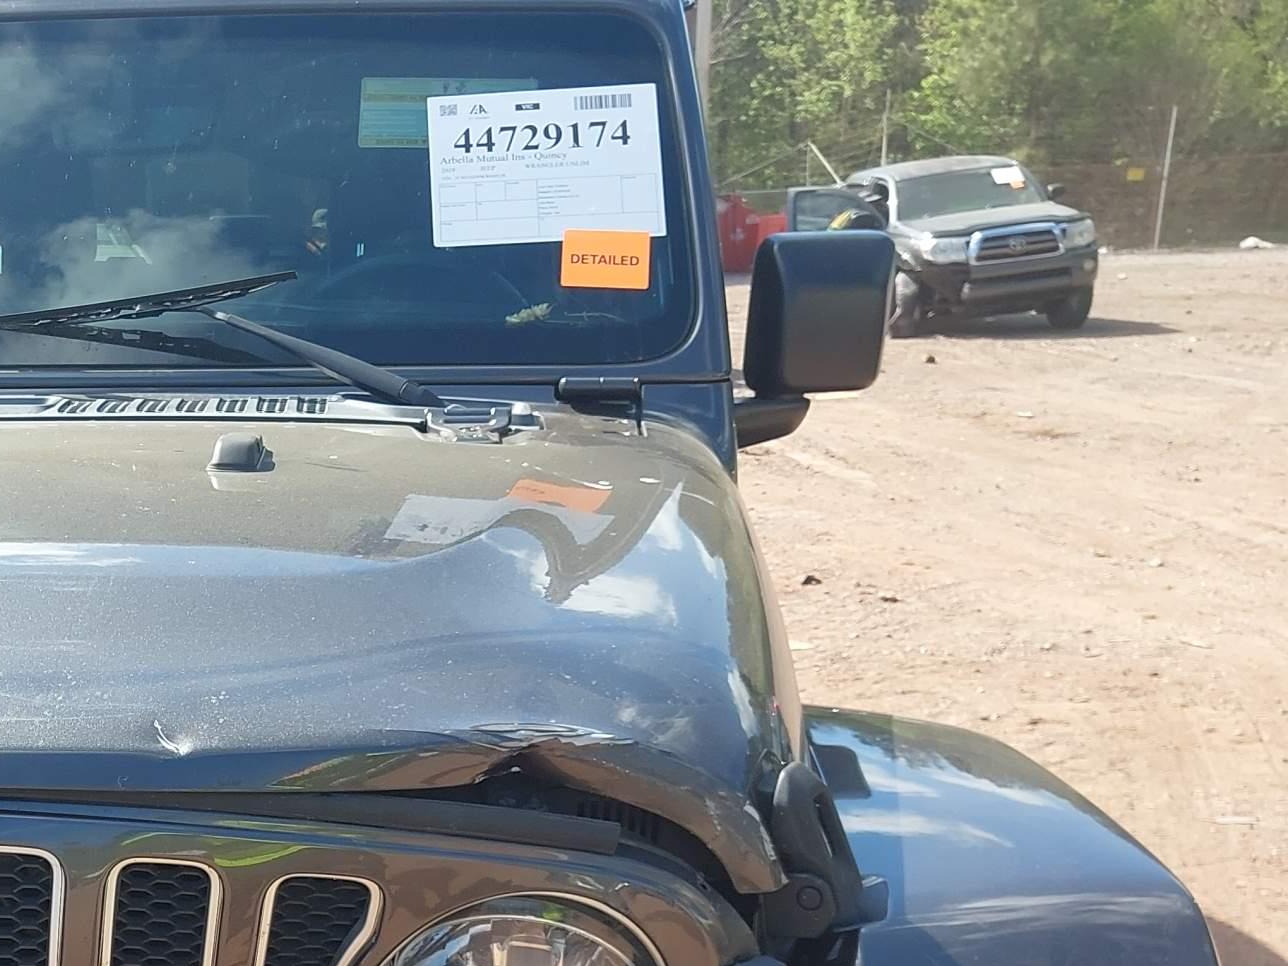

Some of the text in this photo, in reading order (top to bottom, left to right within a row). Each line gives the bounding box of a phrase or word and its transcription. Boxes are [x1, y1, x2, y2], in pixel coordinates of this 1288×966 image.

[453, 119, 632, 154] 44729174
[440, 155, 474, 165] Arbella
[476, 153, 509, 163] Mutual
[511, 152, 525, 161] Ins
[534, 151, 567, 161] Quincy
[570, 253, 640, 266] DETAILED
